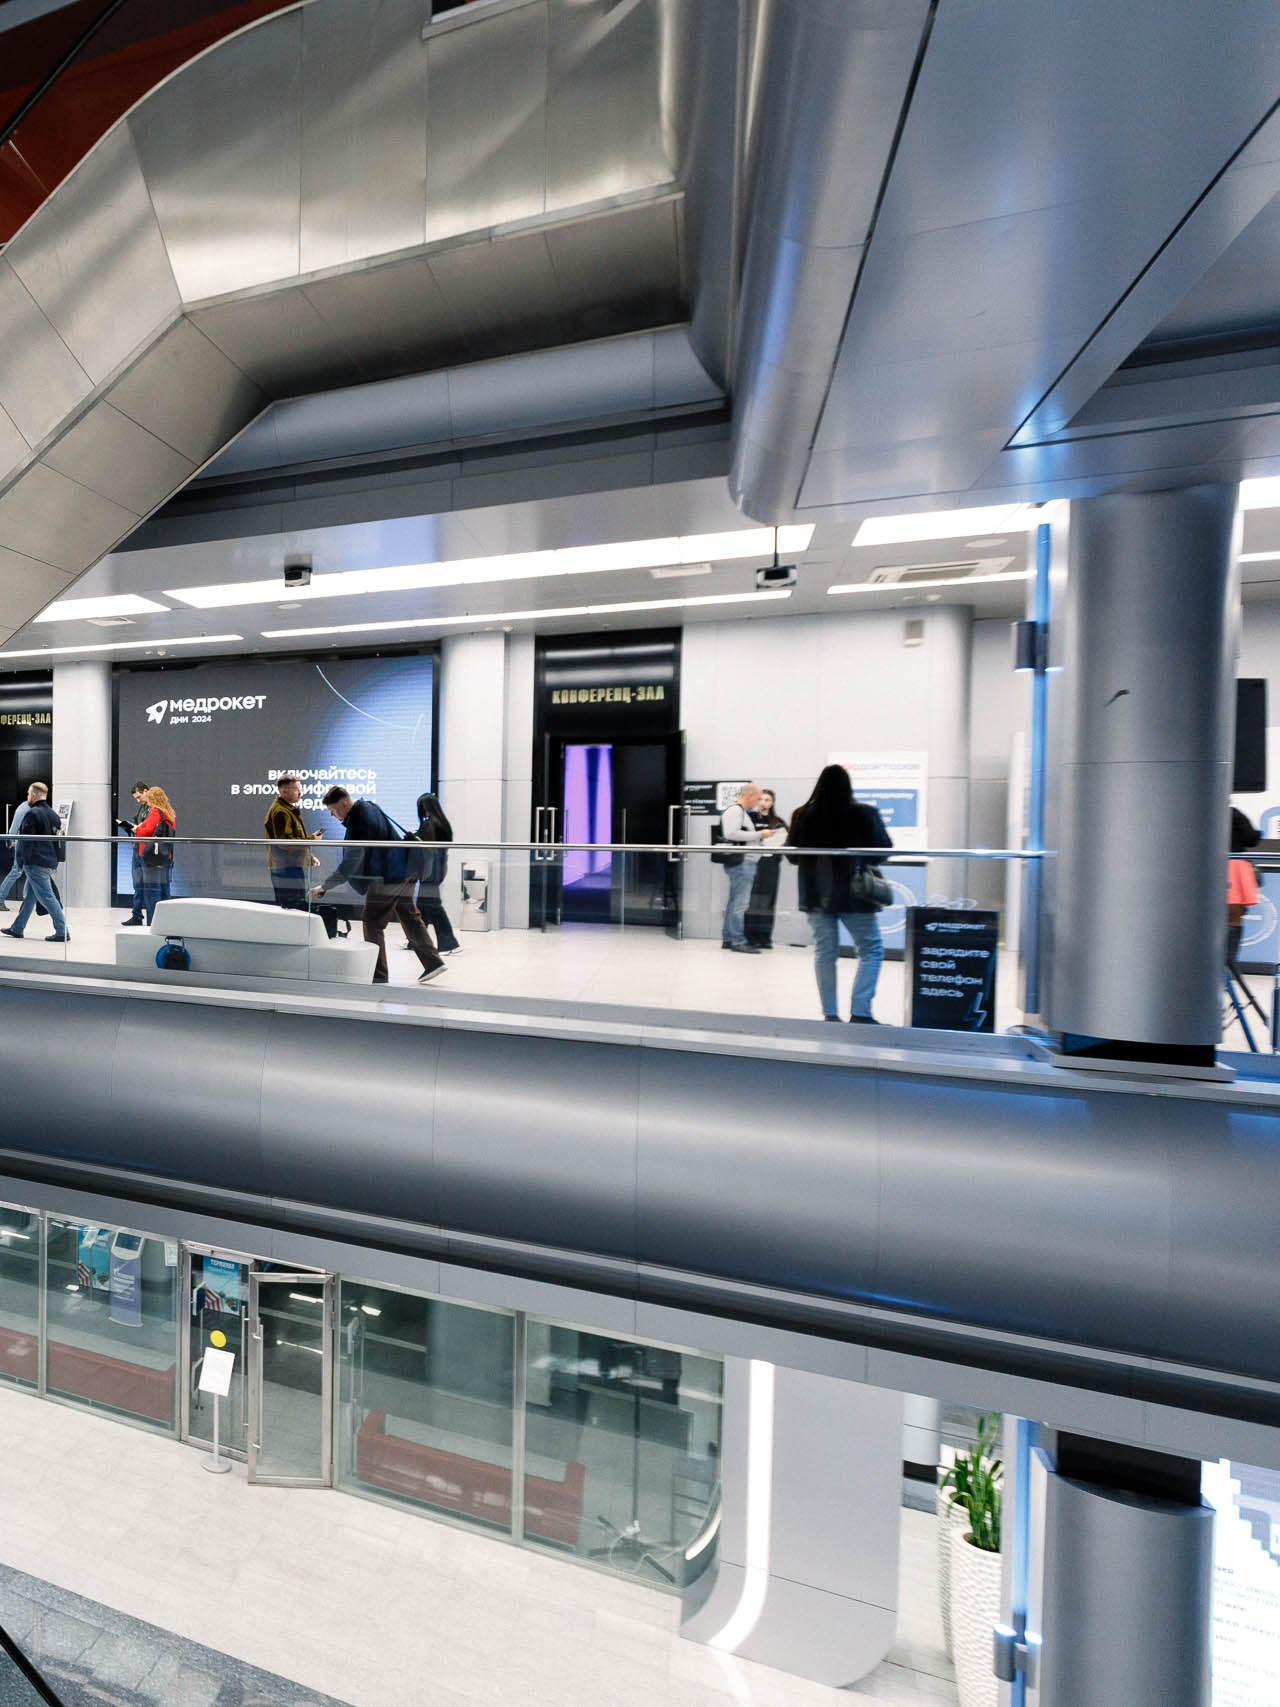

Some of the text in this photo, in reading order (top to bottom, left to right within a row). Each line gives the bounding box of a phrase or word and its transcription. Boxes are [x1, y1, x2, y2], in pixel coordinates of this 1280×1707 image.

[552, 685, 665, 704] КОНФЕРЕНЦ-ЗАЛ
[169, 695, 267, 713] медрокет
[191, 715, 213, 723] 2024
[231, 784, 240, 795] в
[920, 947, 990, 958] зарядите
[920, 960, 957, 970] свой
[920, 974, 984, 986] телефон
[920, 987, 964, 998] здесь
